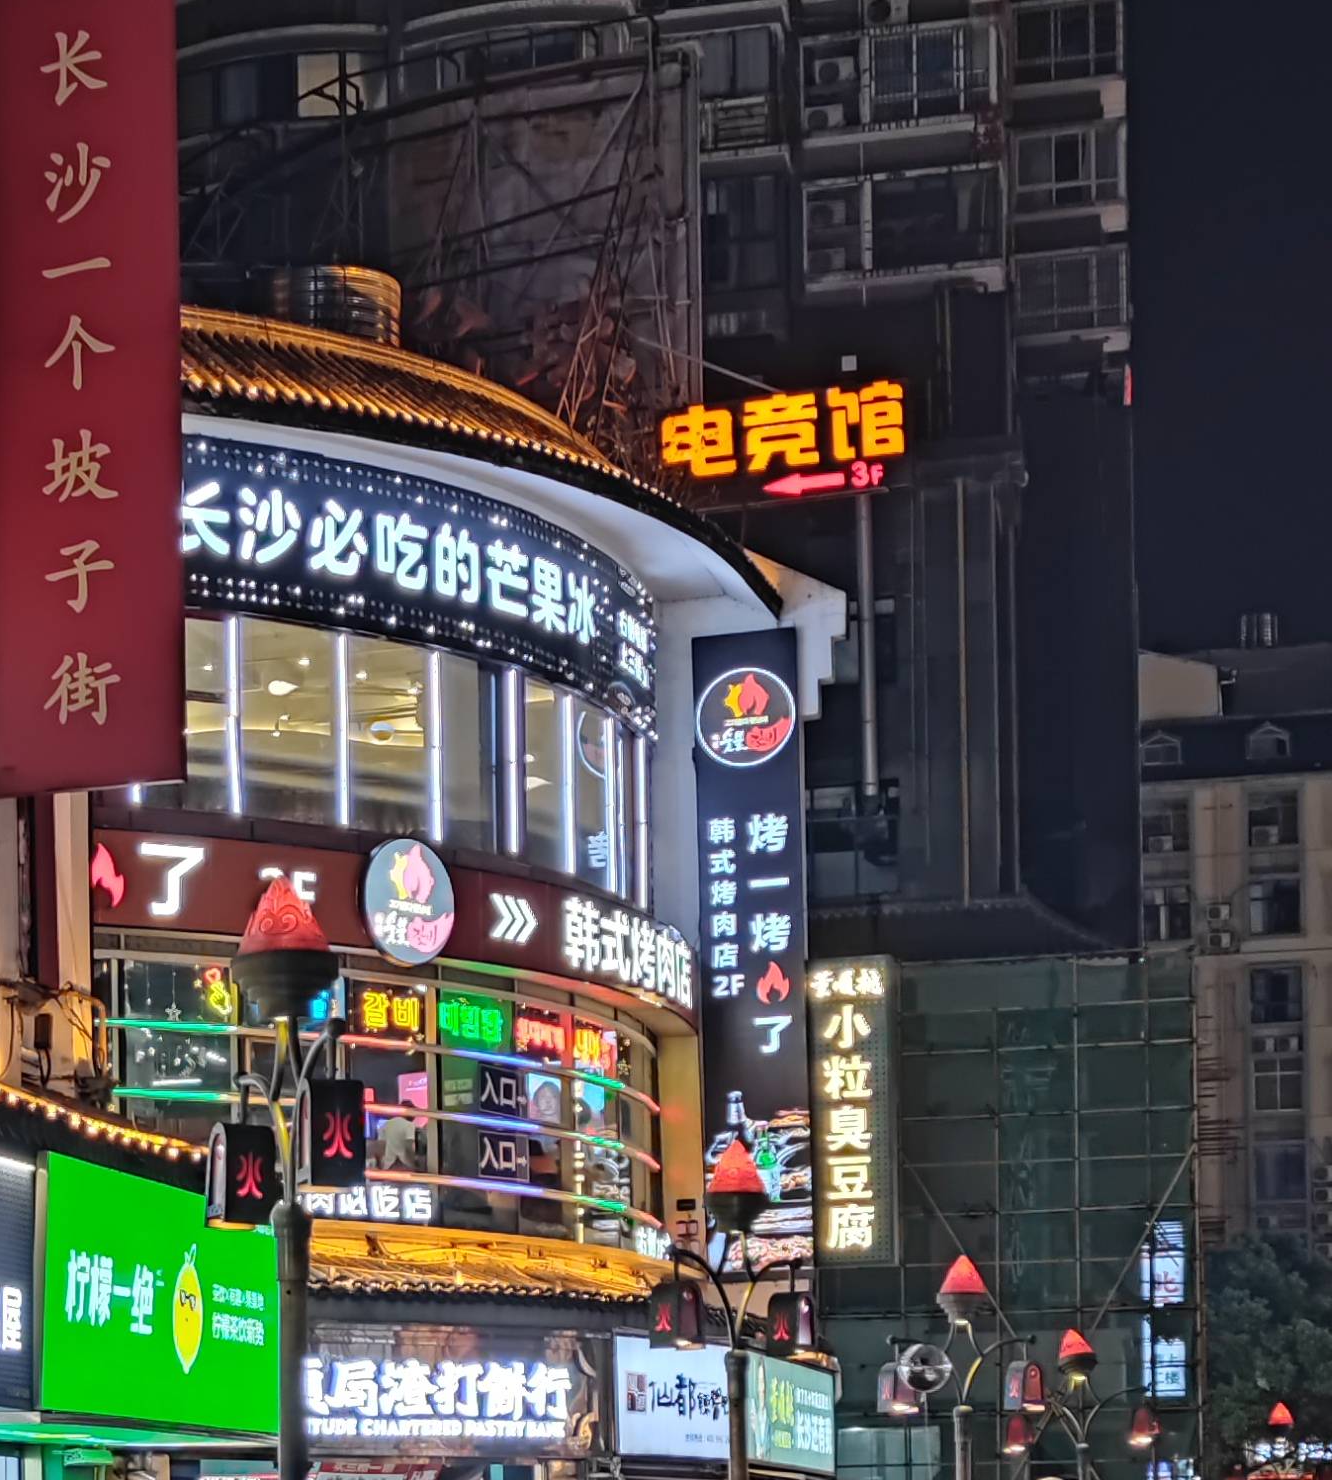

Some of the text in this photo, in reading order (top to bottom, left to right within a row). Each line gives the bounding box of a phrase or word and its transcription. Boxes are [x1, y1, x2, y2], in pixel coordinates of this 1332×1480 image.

[662, 380, 906, 479] 电竞馆
[852, 462, 885, 487] 3F
[183, 480, 598, 644] 长沙必吃的芒果冰
[139, 842, 205, 916] 了
[563, 896, 693, 1010] 韩式烤肉店
[362, 991, 420, 1031] 갈비
[479, 1073, 517, 1111] 入口
[479, 1137, 517, 1172] 入口
[822, 1003, 875, 1249] 小粒臭豆腐
[467, 1420, 525, 1437] PASTRY
